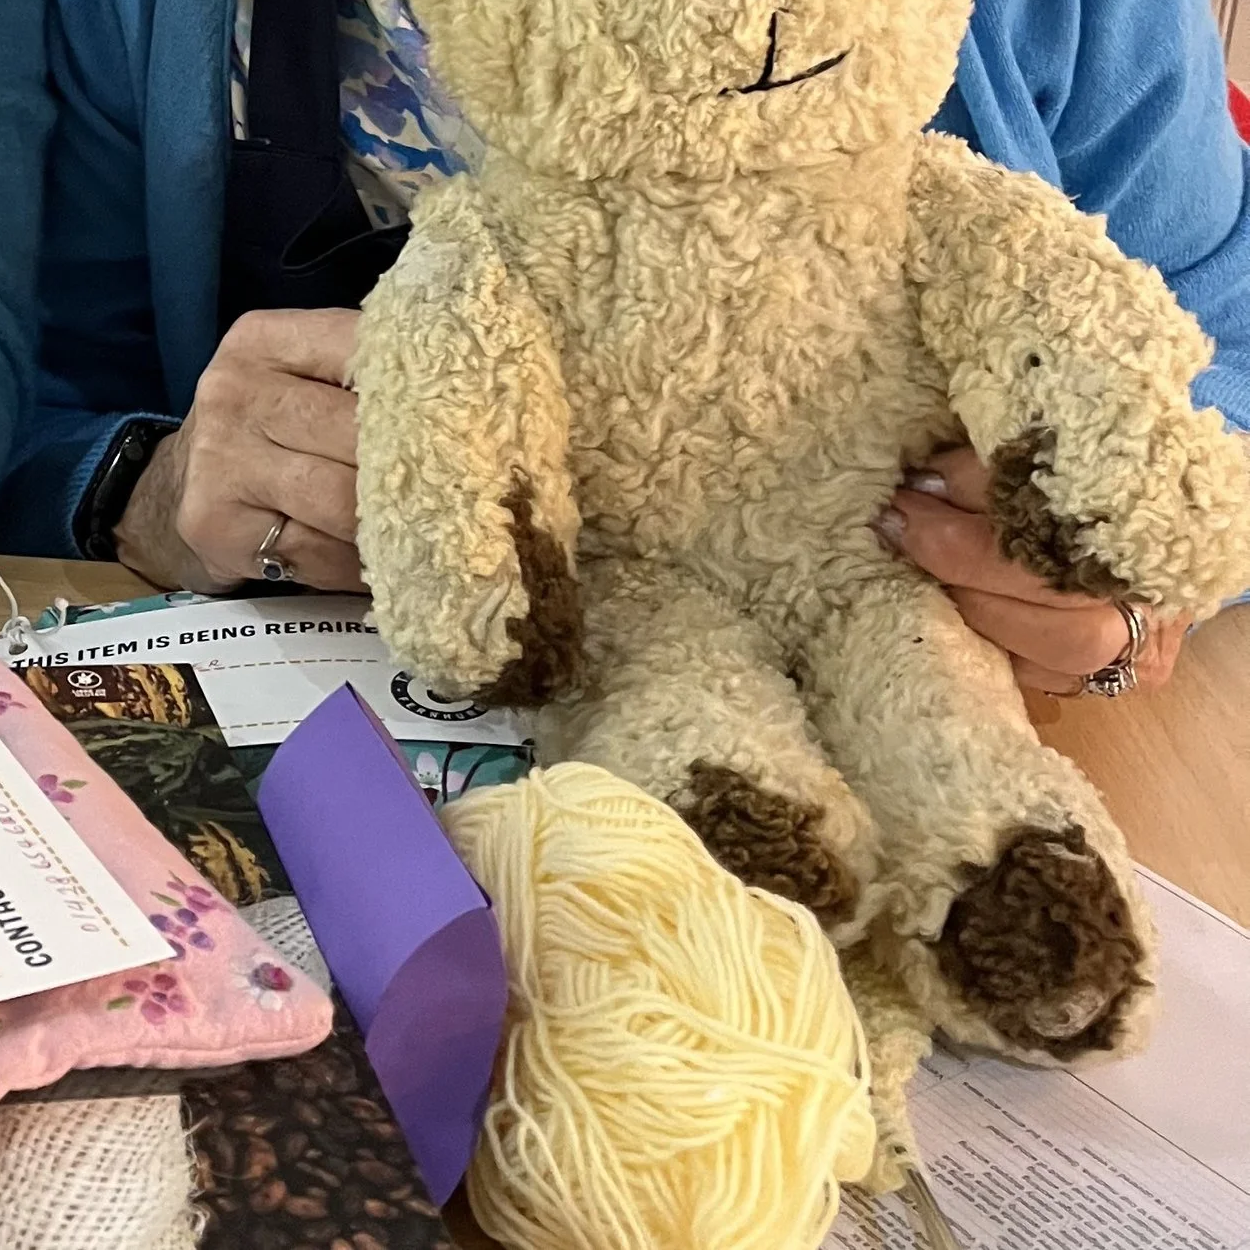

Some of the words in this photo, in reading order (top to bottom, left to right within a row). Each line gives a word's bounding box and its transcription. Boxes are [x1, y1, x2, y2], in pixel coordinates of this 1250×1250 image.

[12, 652, 69, 668] THIS
[78, 640, 138, 661] ITEM
[147, 636, 170, 650] IS
[179, 625, 256, 645] BEING
